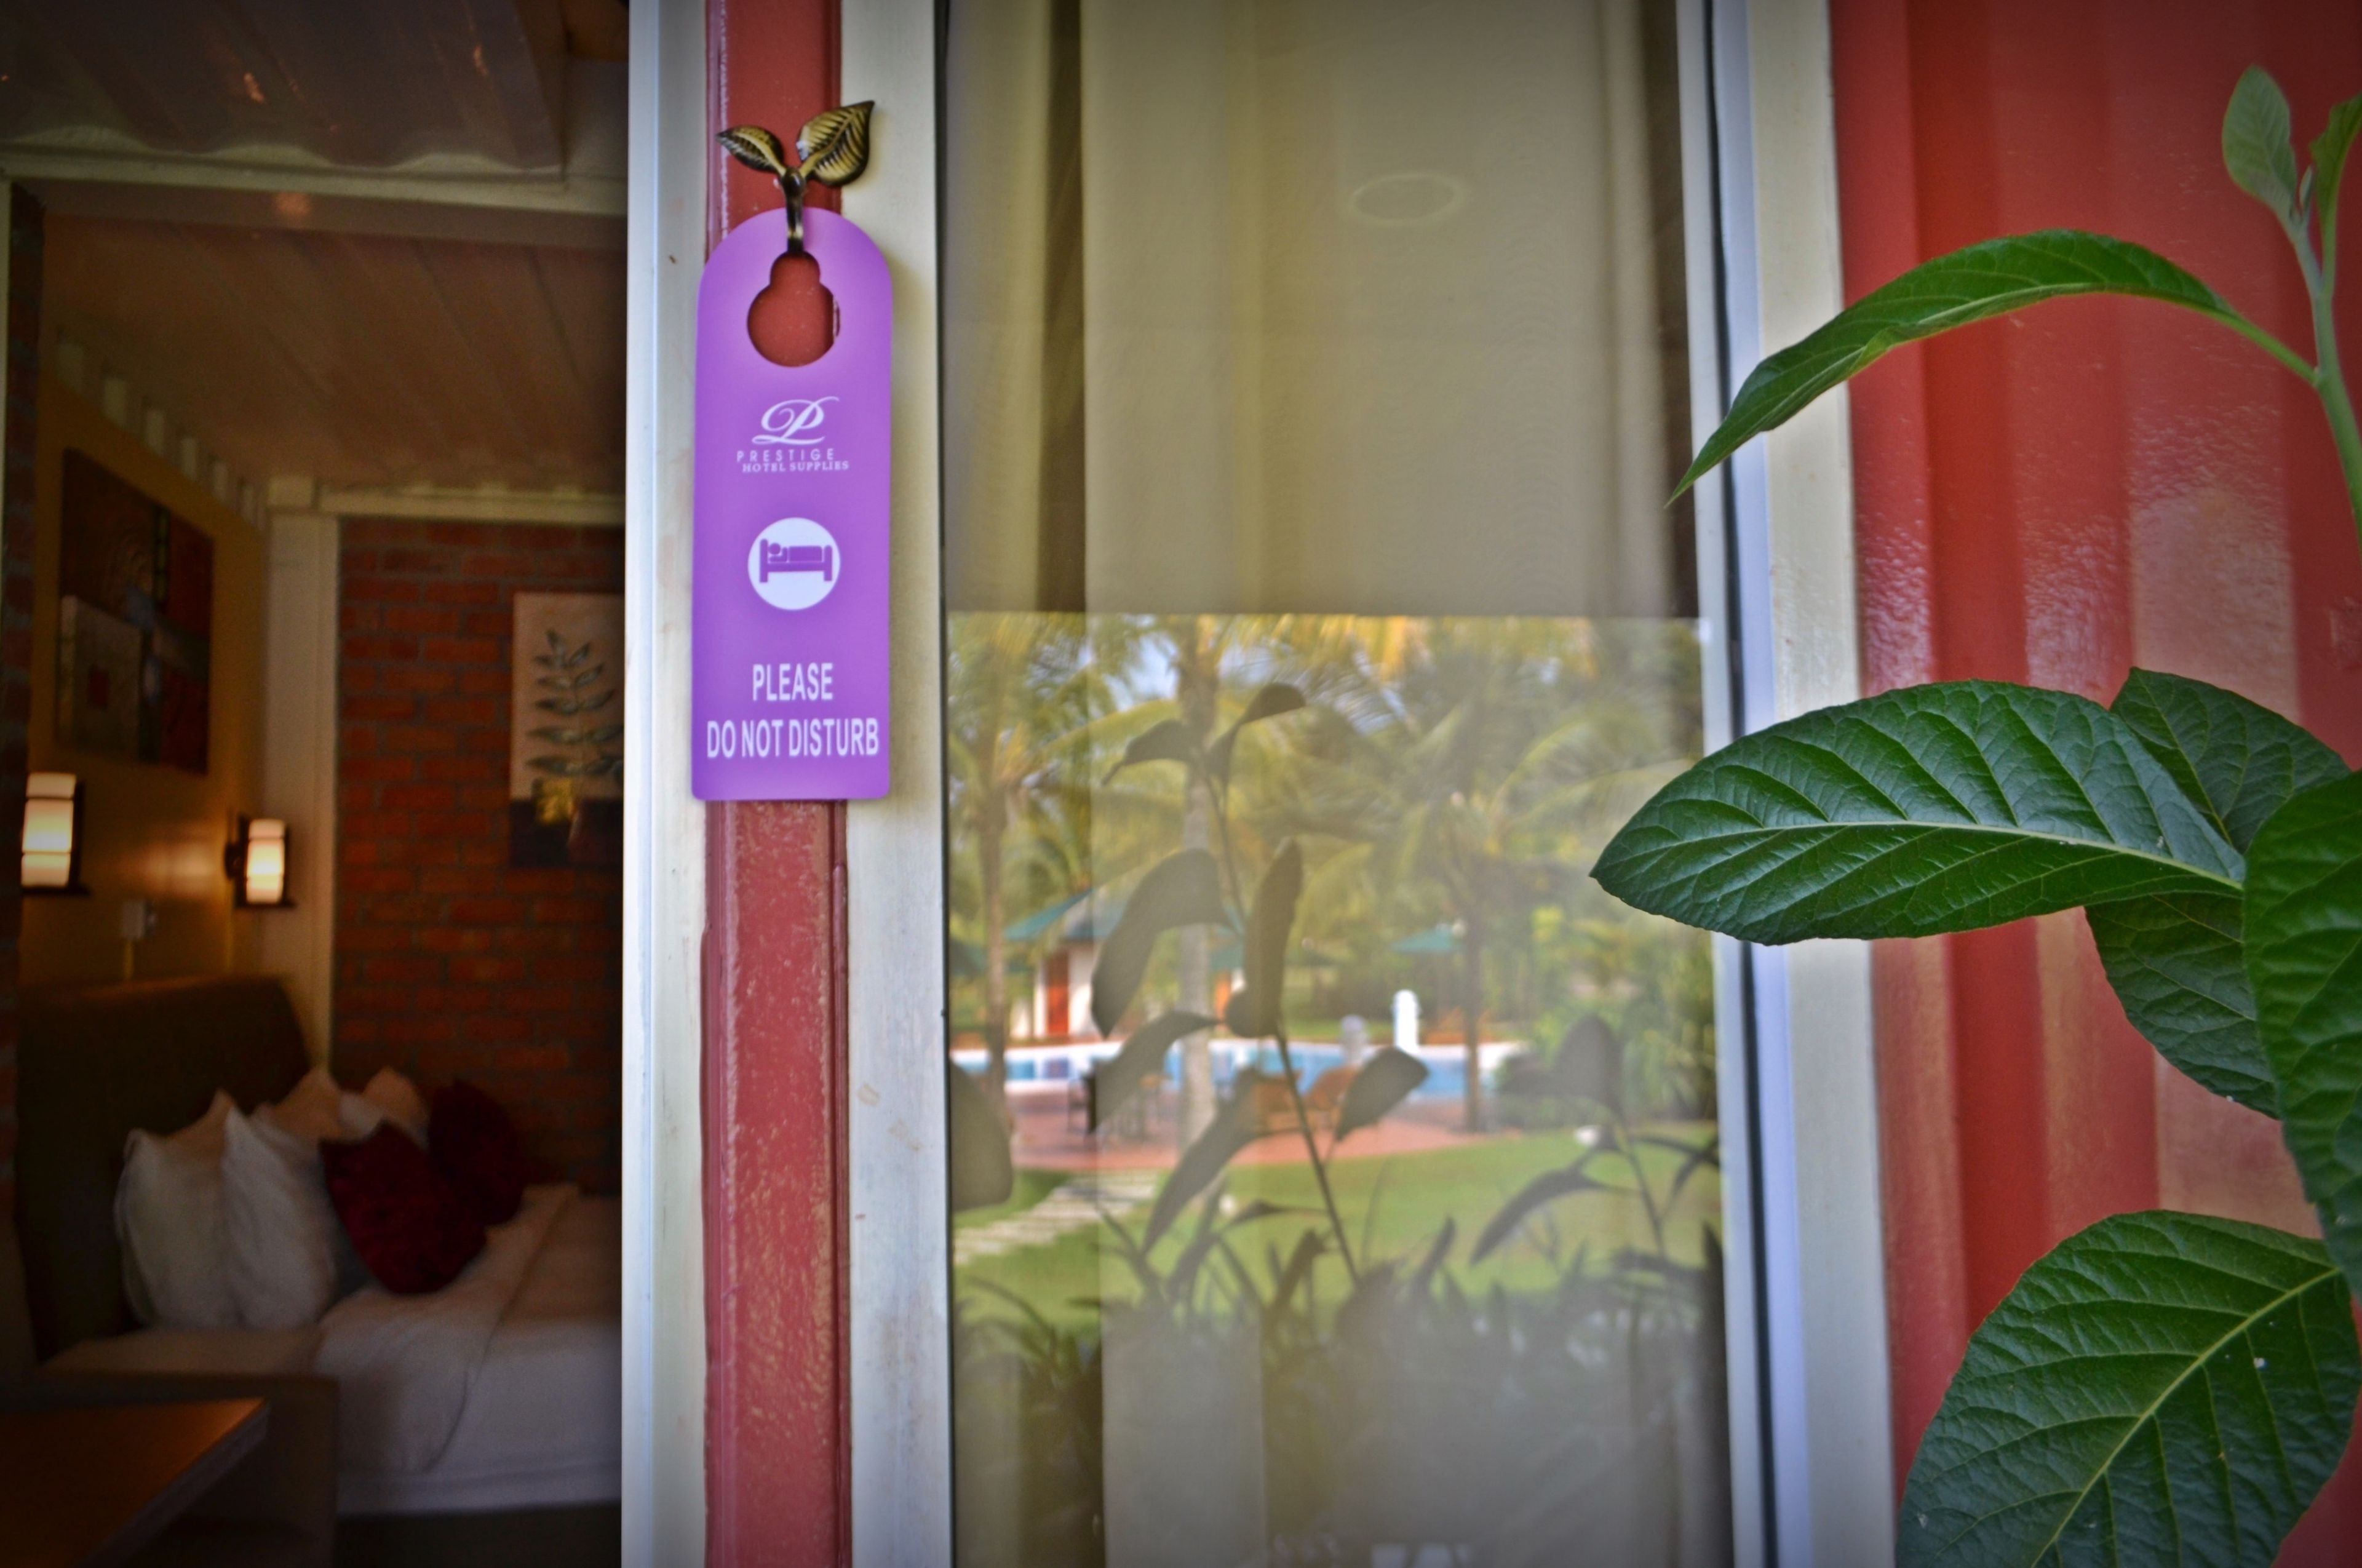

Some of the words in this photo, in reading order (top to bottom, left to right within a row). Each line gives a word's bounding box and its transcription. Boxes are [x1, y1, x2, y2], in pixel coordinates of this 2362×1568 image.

[737, 448, 835, 463] PRESTIGE
[742, 461, 786, 473] HOTEL
[790, 460, 849, 471] SUPPLIES
[752, 663, 833, 701] PLEASE
[707, 720, 736, 758] DO
[742, 719, 784, 757] NOT
[789, 718, 879, 757] DISTURB
